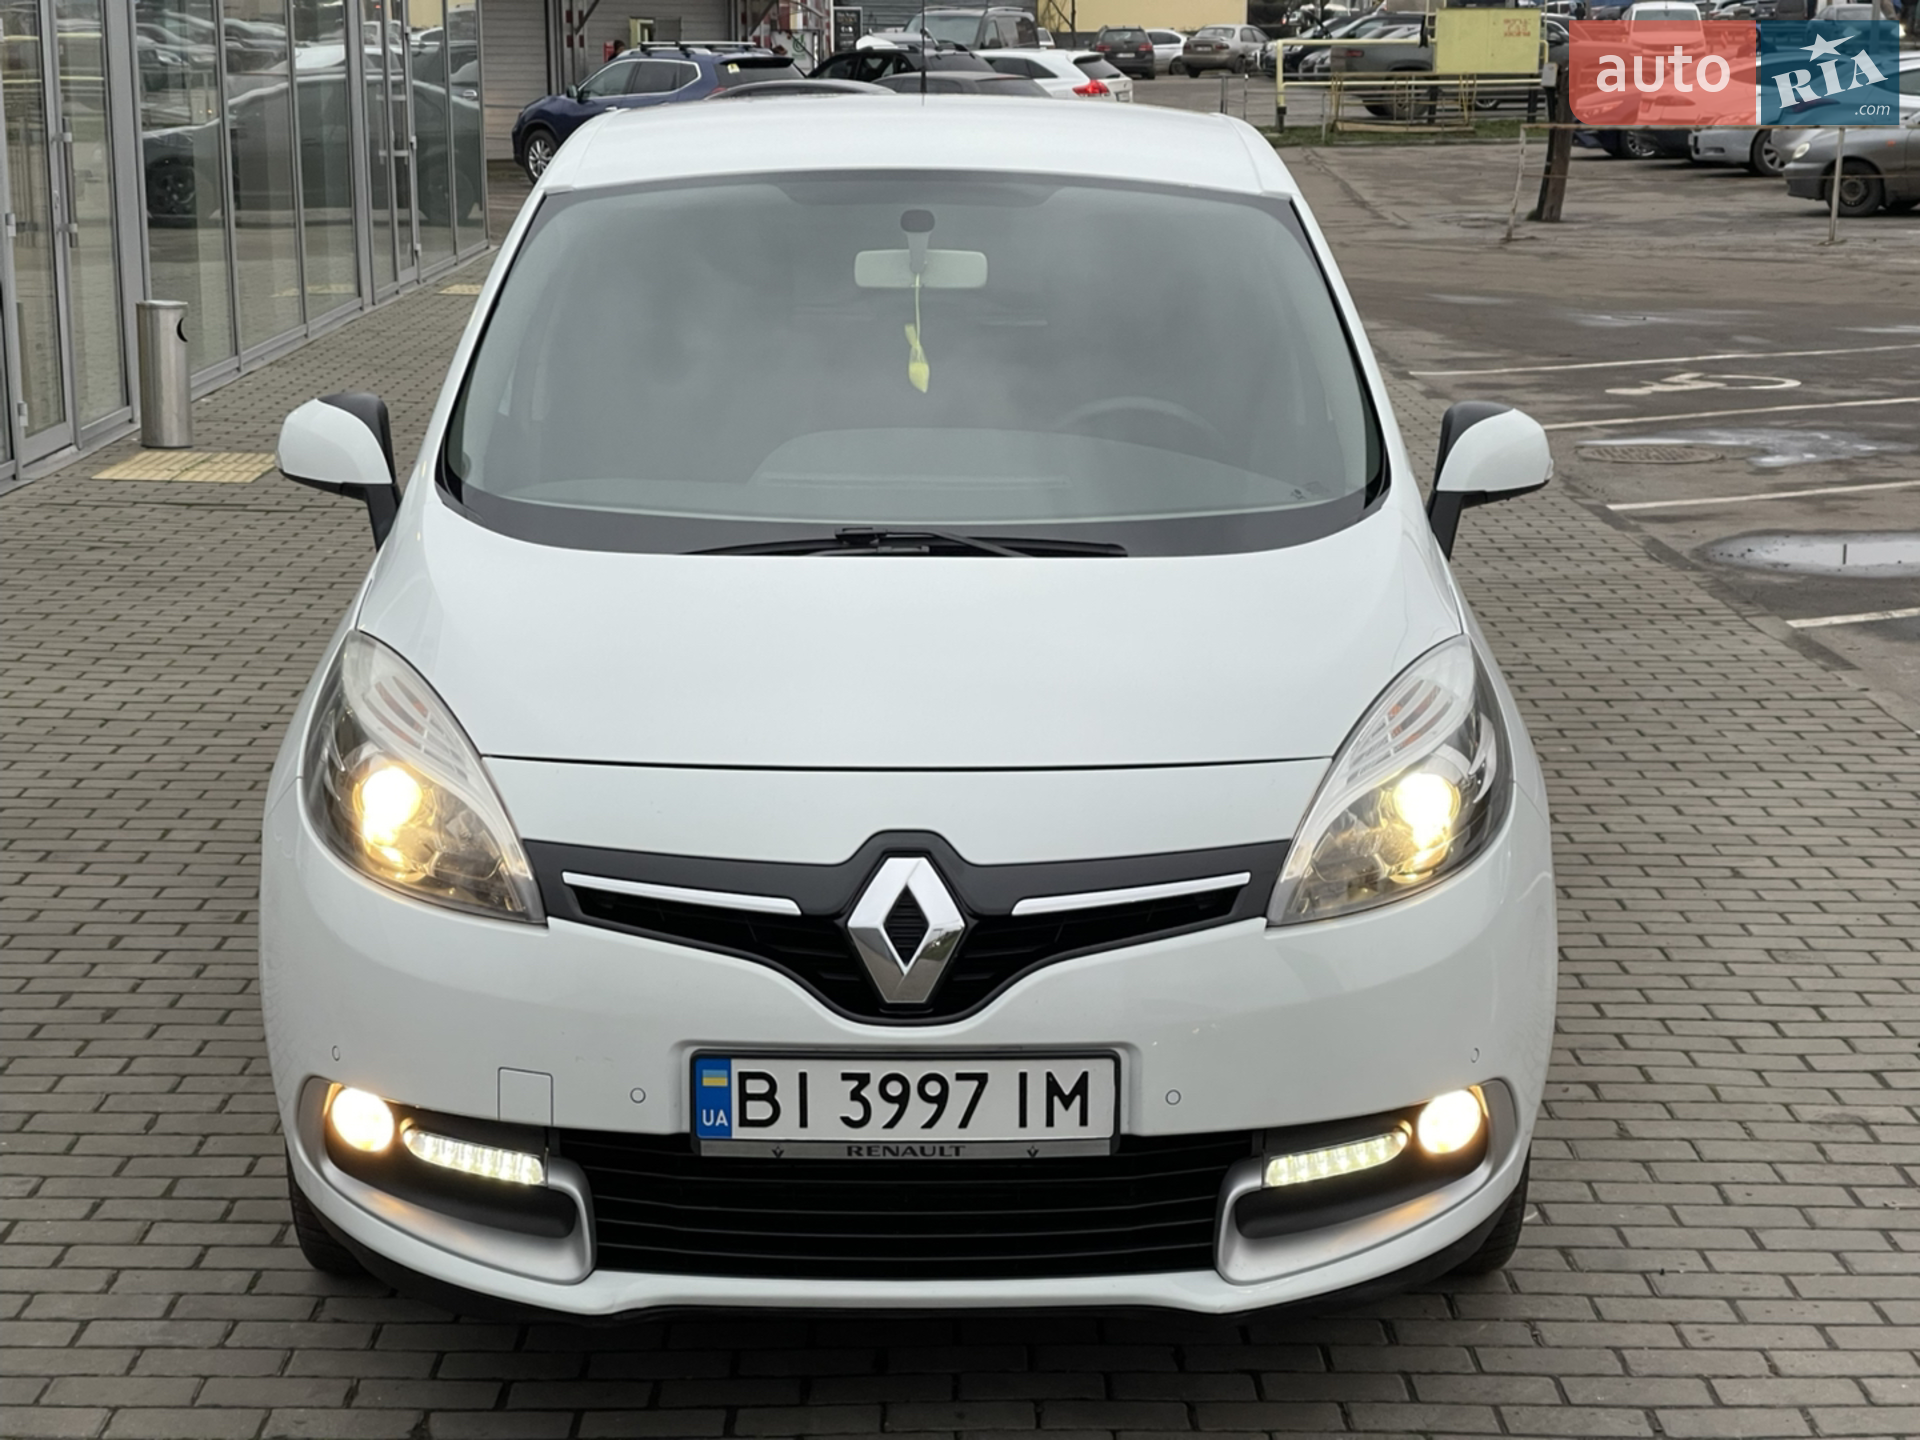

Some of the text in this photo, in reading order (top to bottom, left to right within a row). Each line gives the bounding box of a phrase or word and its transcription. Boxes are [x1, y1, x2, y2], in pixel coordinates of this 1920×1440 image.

[737, 1070, 1090, 1130] BI 3997 IM
[702, 1109, 728, 1126] UA
[846, 1145, 966, 1157] RENAULT
